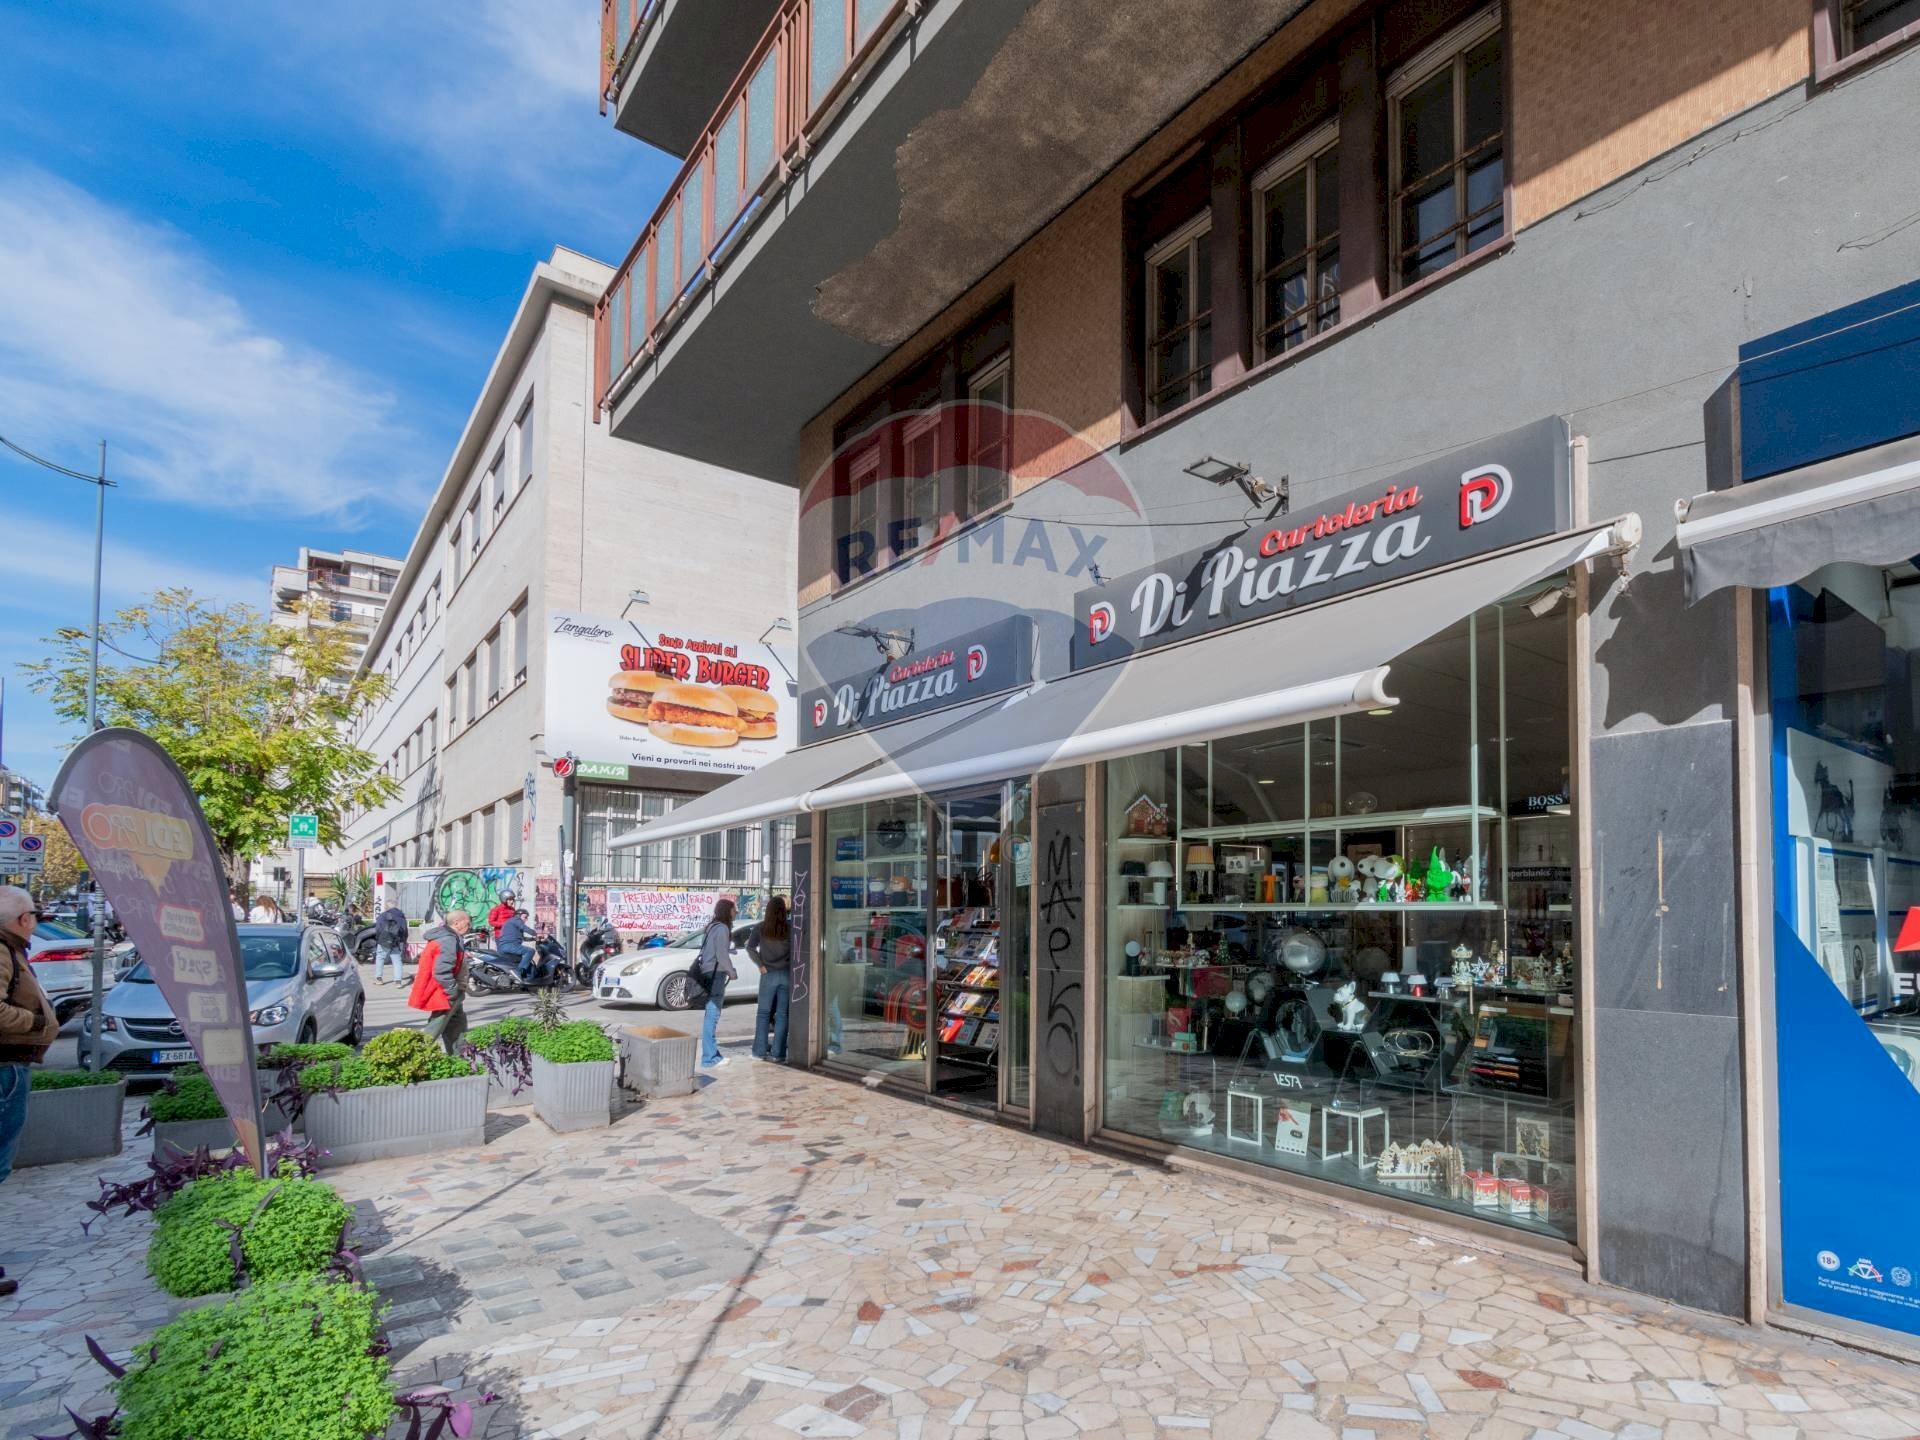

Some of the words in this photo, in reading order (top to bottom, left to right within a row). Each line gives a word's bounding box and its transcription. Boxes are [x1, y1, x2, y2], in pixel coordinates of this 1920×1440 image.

[1259, 484, 1424, 558] Cartoleria
[1130, 572, 1192, 637] Di
[1203, 513, 1431, 617] Piazza
[619, 644, 691, 681] SLIDER
[695, 655, 770, 692] BURGER
[890, 650, 955, 684] Cartoleria
[834, 683, 861, 726] Di
[868, 669, 958, 717] Piazza
[631, 753, 654, 763] Vieni
[664, 757, 697, 766] provarli
[713, 761, 735, 769] nostri
[1528, 794, 1563, 807] BOSS
[1273, 1073, 1303, 1089] VESTA
